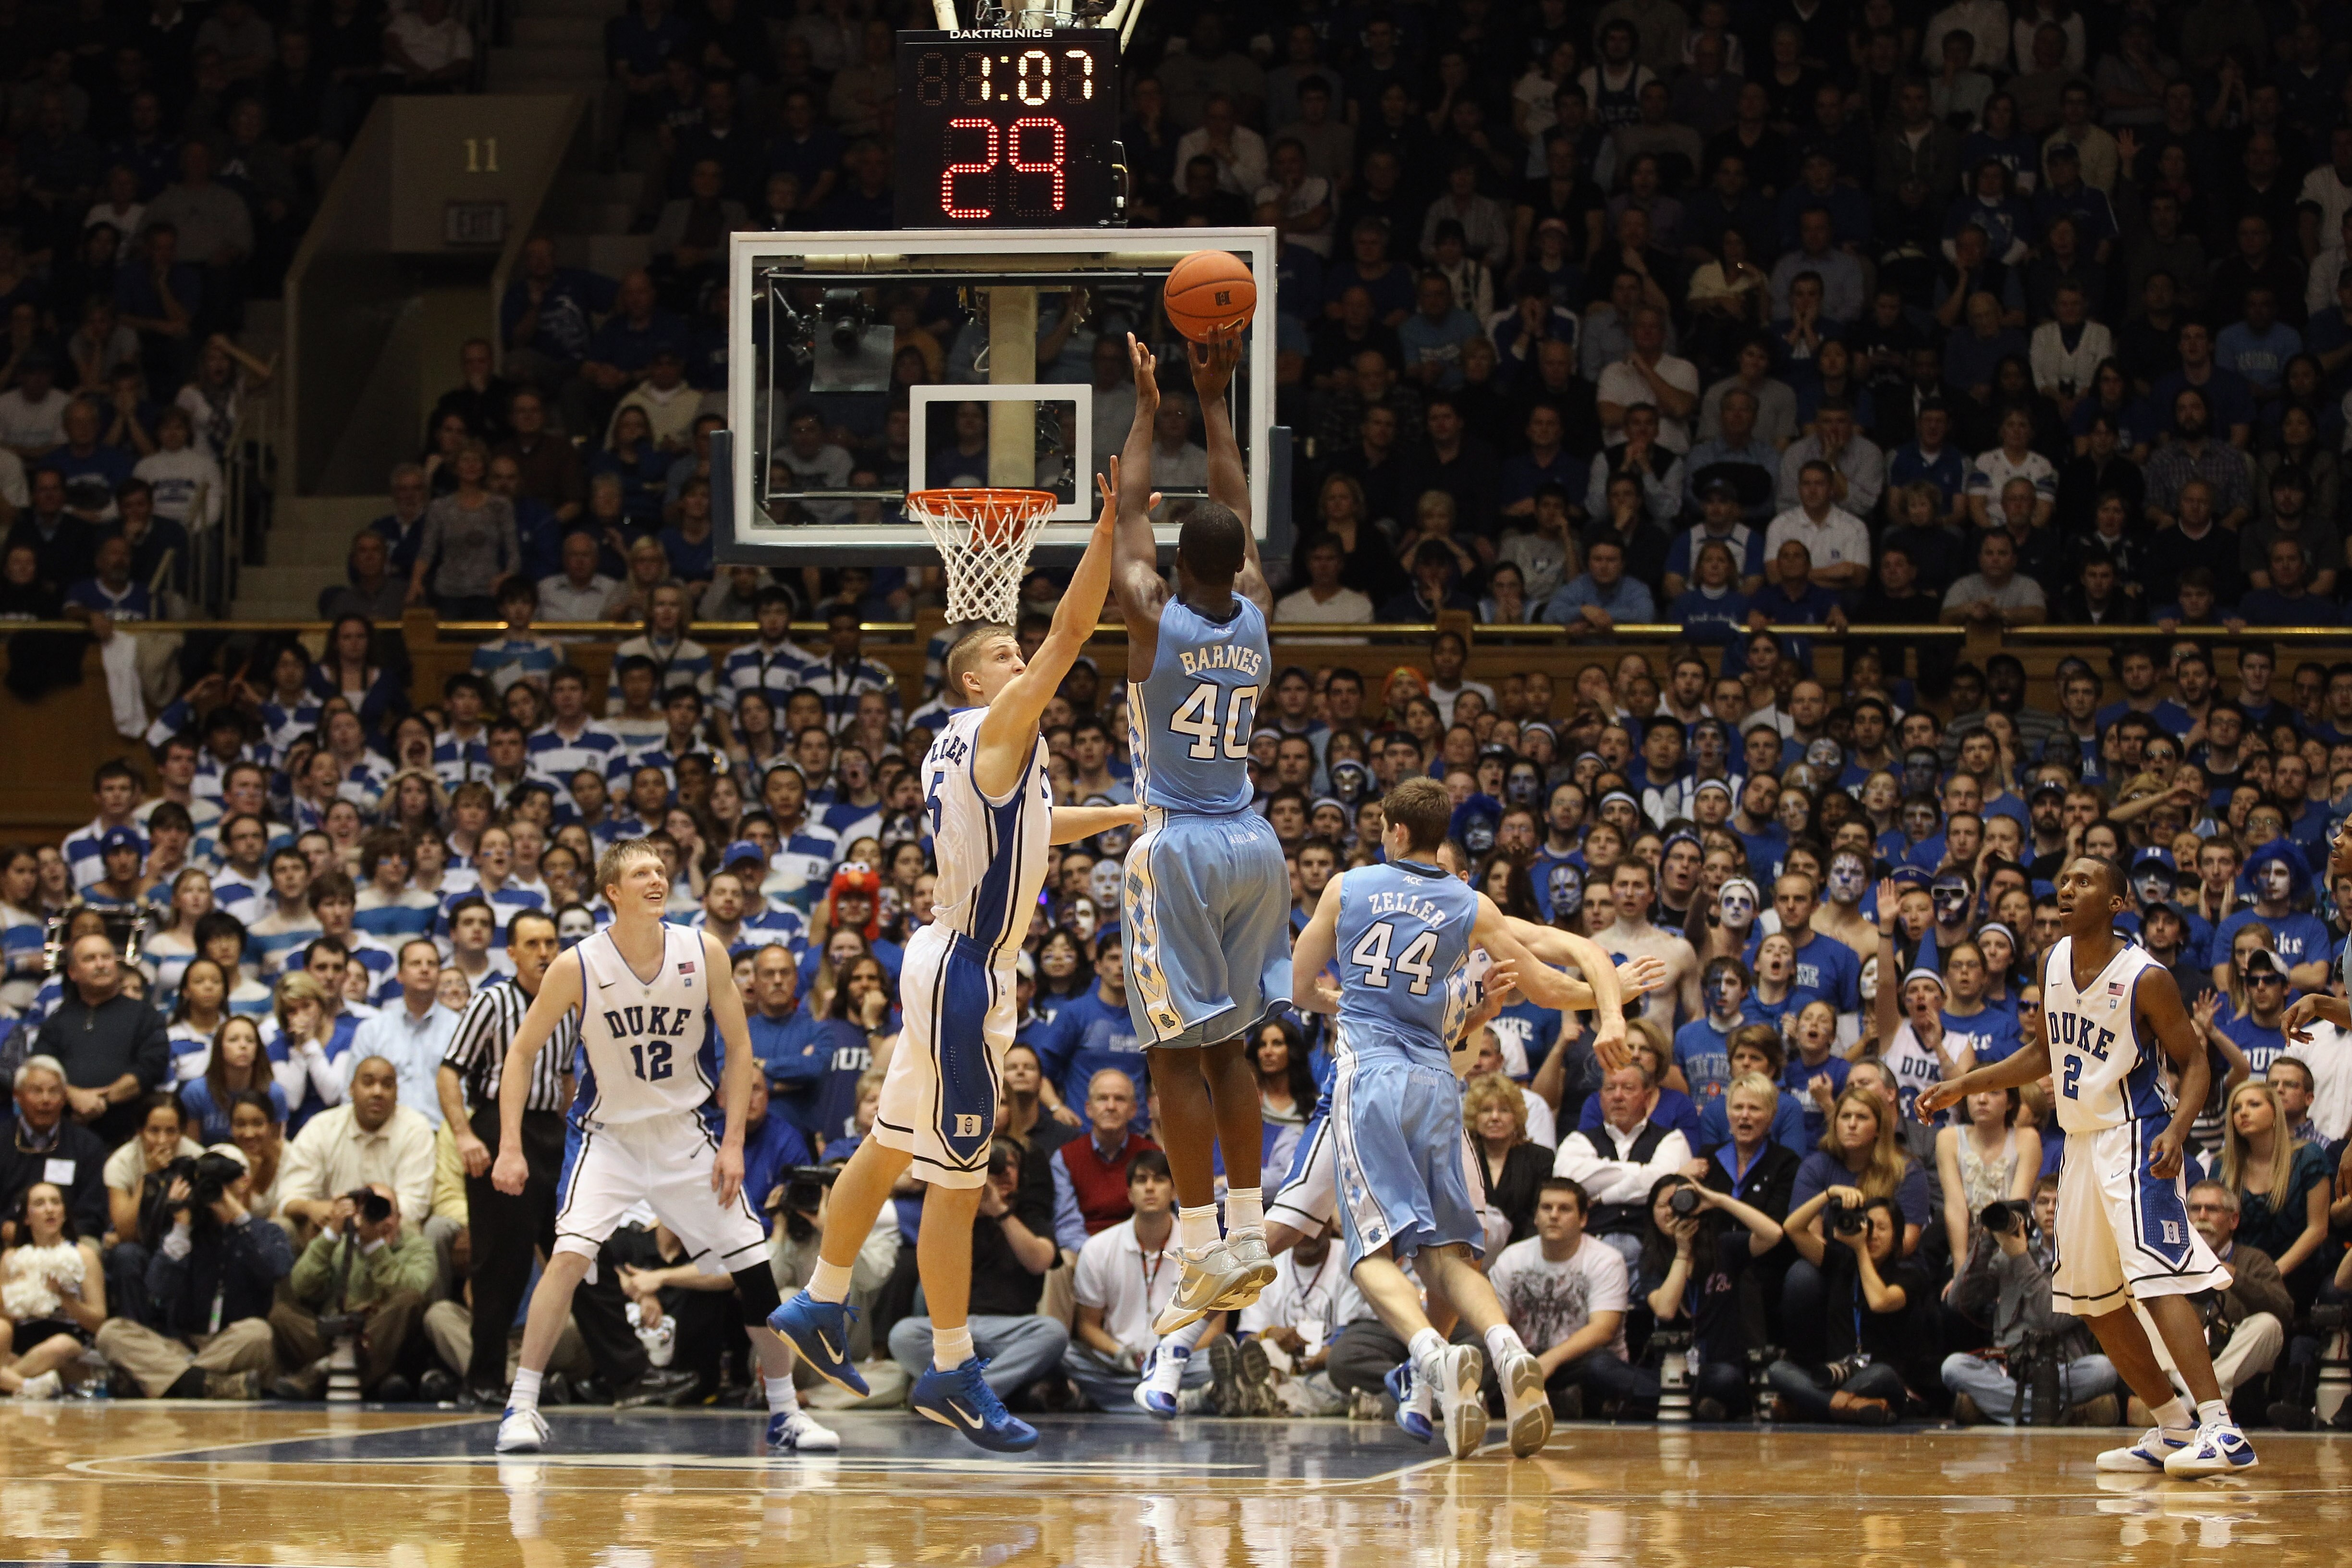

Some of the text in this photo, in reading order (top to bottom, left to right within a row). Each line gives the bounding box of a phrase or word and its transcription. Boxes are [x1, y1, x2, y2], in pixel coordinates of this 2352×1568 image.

[949, 28, 1054, 39] DAKTRONICS
[981, 49, 1093, 106] 1:07
[463, 138, 499, 173] 11
[941, 118, 1065, 218] 29
[1179, 645, 1262, 676] BARNES
[1168, 683, 1259, 760] 40
[1403, 875, 1423, 886] ACC
[1368, 892, 1446, 929] ZELLER
[1350, 920, 1439, 996] 44
[603, 1006, 691, 1039] DUKE
[2048, 1012, 2115, 1062] DUKE
[630, 1040, 672, 1082] 12
[2062, 1054, 2082, 1100] 2
